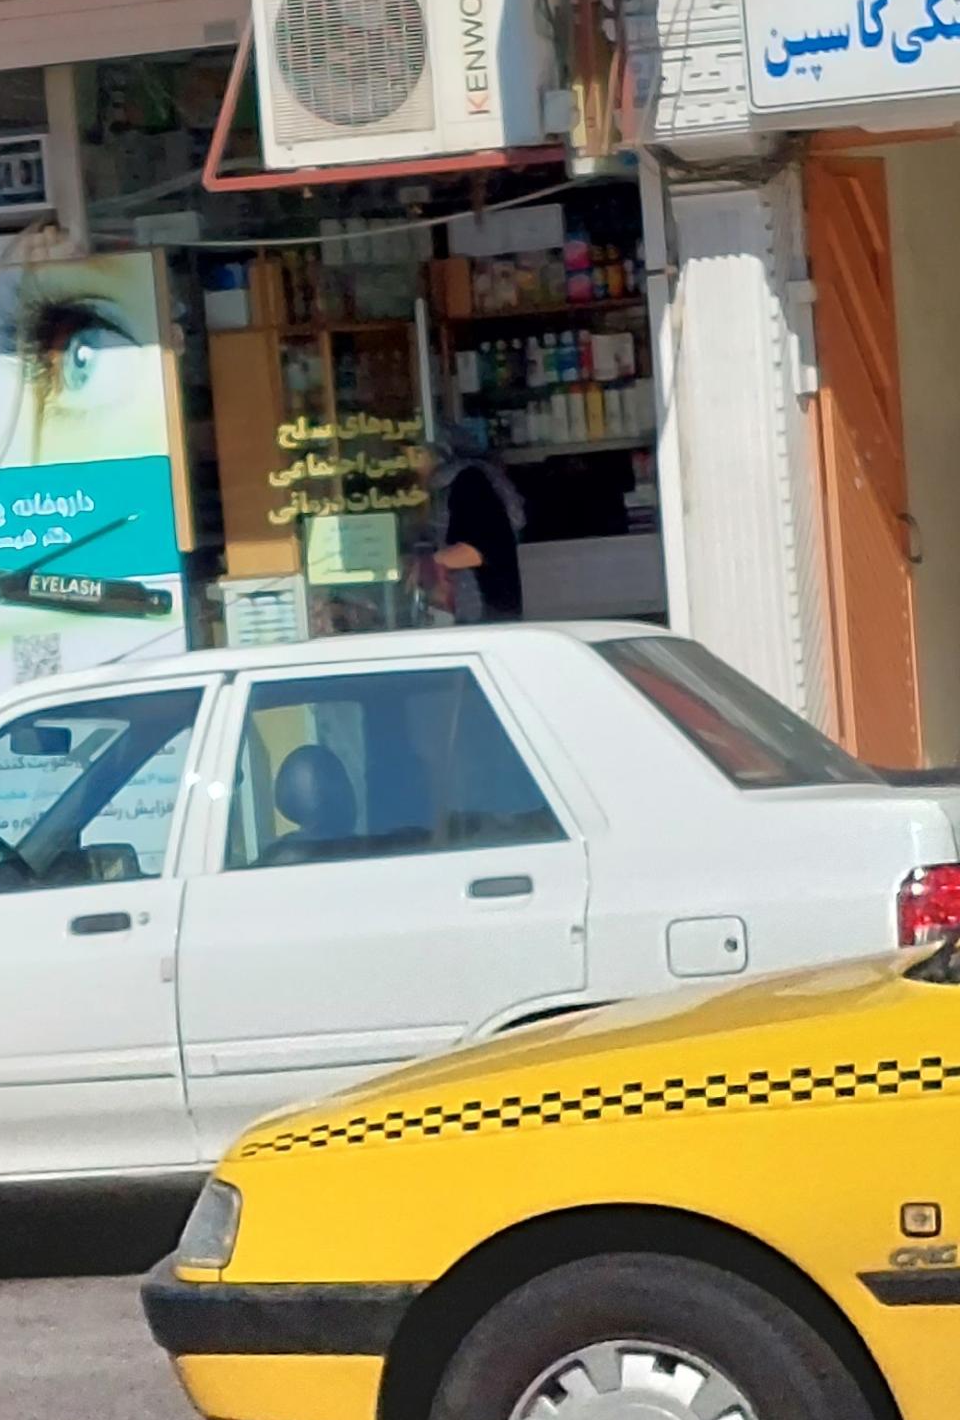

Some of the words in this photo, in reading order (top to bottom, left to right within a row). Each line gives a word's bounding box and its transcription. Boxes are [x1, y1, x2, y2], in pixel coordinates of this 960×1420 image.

[268, 451, 366, 488] اجتماعی
[10, 488, 96, 518] داروخانه
[346, 484, 431, 513] خدمات
[29, 574, 103, 597] EYELASH
